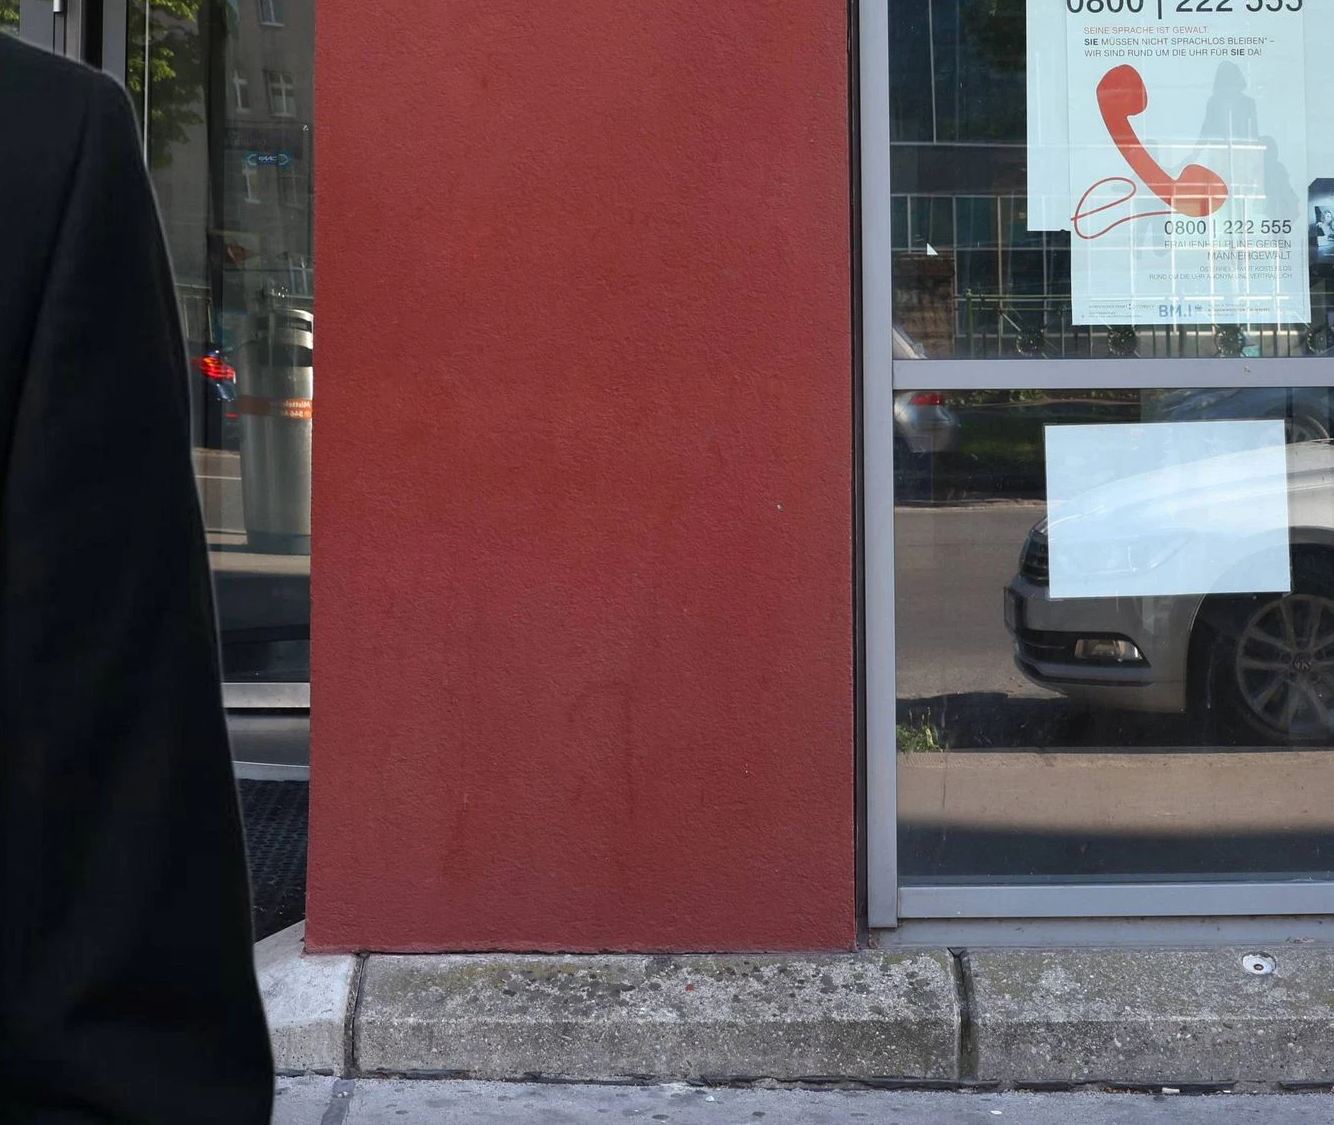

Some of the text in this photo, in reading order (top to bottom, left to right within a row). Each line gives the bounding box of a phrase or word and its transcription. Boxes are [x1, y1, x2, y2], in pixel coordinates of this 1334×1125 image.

[1084, 27, 1110, 35] SEINE
[1112, 26, 1154, 35] SPRACHE
[1156, 26, 1170, 34] IST
[1084, 38, 1099, 46] SIE
[1101, 37, 1140, 46] MÜSSEN
[1141, 37, 1168, 45] NICHT
[1171, 37, 1226, 45] SPRACHLOS
[1084, 49, 1101, 57] WIR
[1103, 49, 1125, 57] SIND
[1127, 49, 1153, 57] RUND
[1188, 48, 1208, 56] UHR
[1210, 47, 1228, 56] FÜR
[1230, 48, 1245, 56] SIE
[1247, 48, 1262, 56] DA!
[1164, 220, 1207, 235] 0800
[1222, 219, 1255, 235] 222
[1260, 219, 1292, 235] 555
